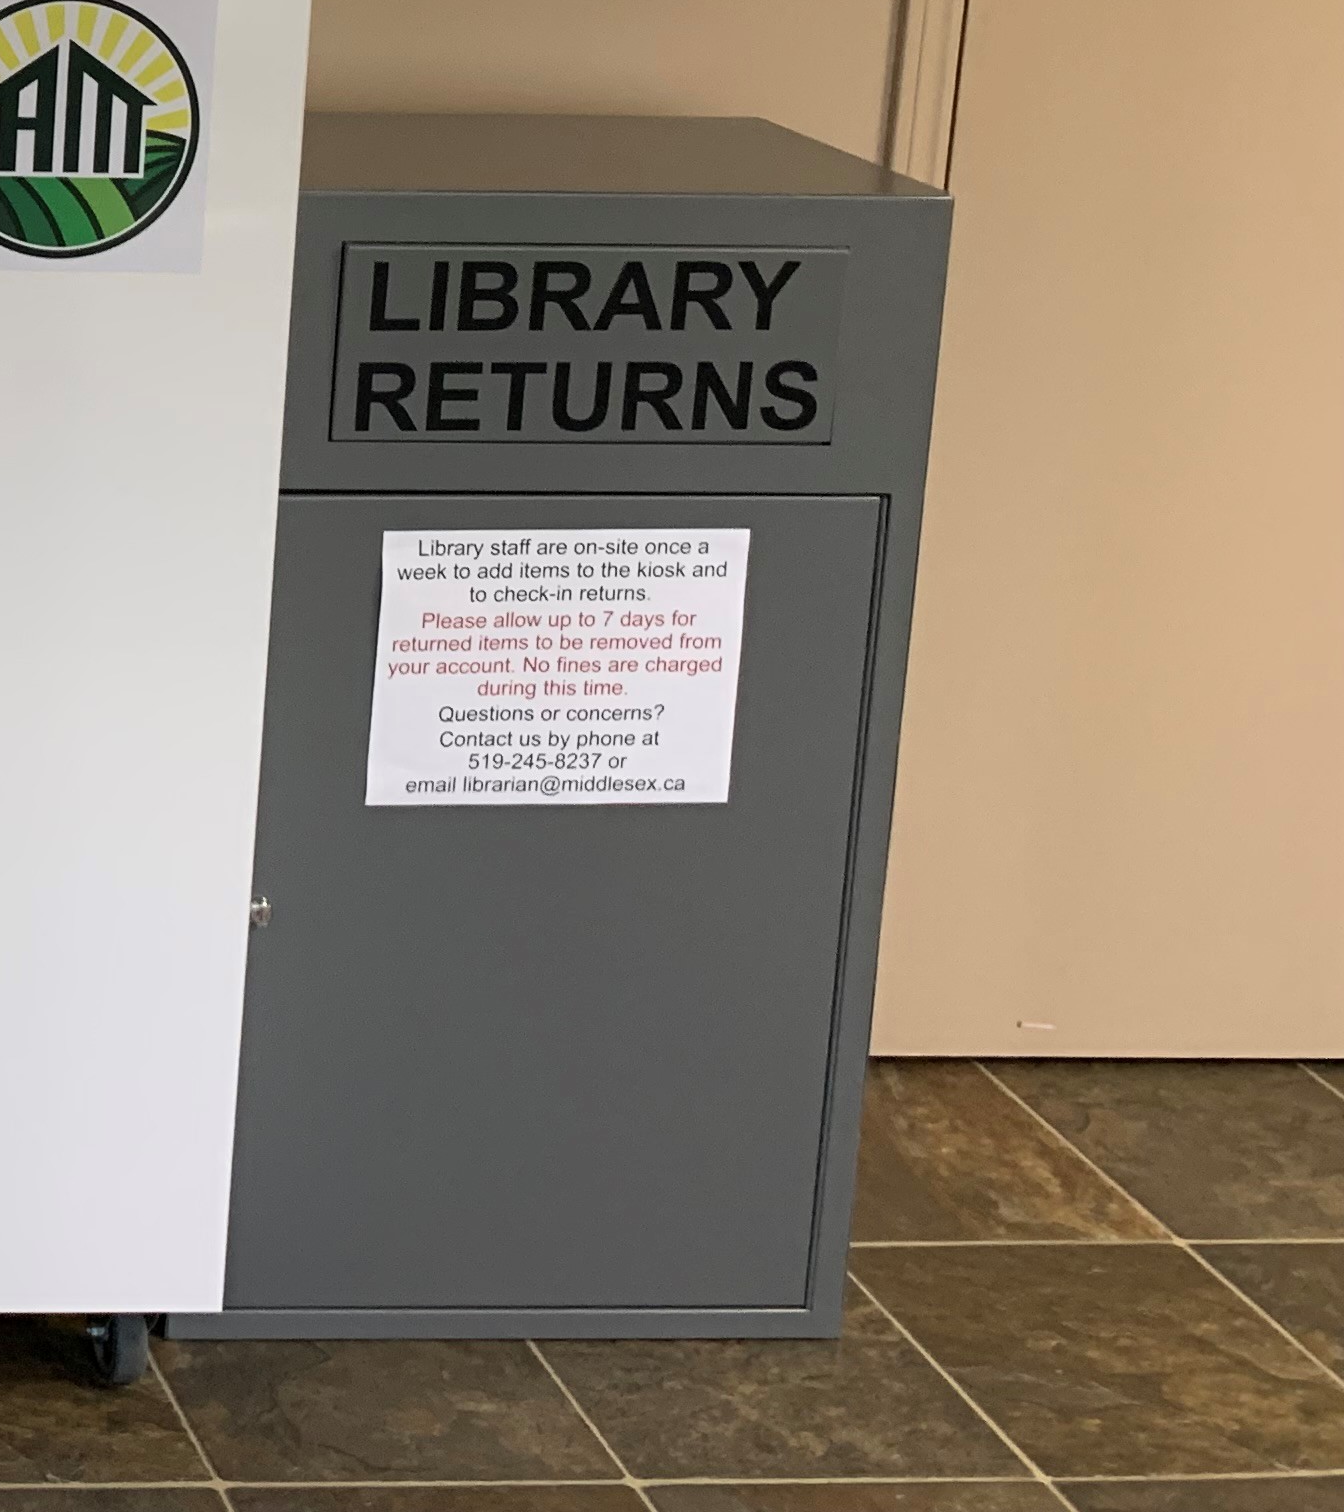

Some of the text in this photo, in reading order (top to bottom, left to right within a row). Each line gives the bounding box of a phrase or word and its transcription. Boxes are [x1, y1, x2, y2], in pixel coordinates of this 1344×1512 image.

[369, 261, 801, 331] LIBRARY
[354, 360, 818, 432] RETURNS
[419, 539, 709, 560] Library staff are on-site once a
[398, 561, 727, 580] week to add items to the kiosk and
[470, 585, 650, 602] to check-in returns.
[422, 610, 697, 631] Please allow up to 7 days for
[393, 633, 721, 652] returned items to be removed from
[388, 657, 722, 678] your account. No fines are charged
[478, 680, 627, 699] during this time.
[439, 704, 664, 722] Questions or concerns?
[440, 731, 658, 750] Contact us by phone at
[469, 753, 627, 769] 519-245-8237 or
[406, 776, 685, 796] email librarian@middlesex.ca
